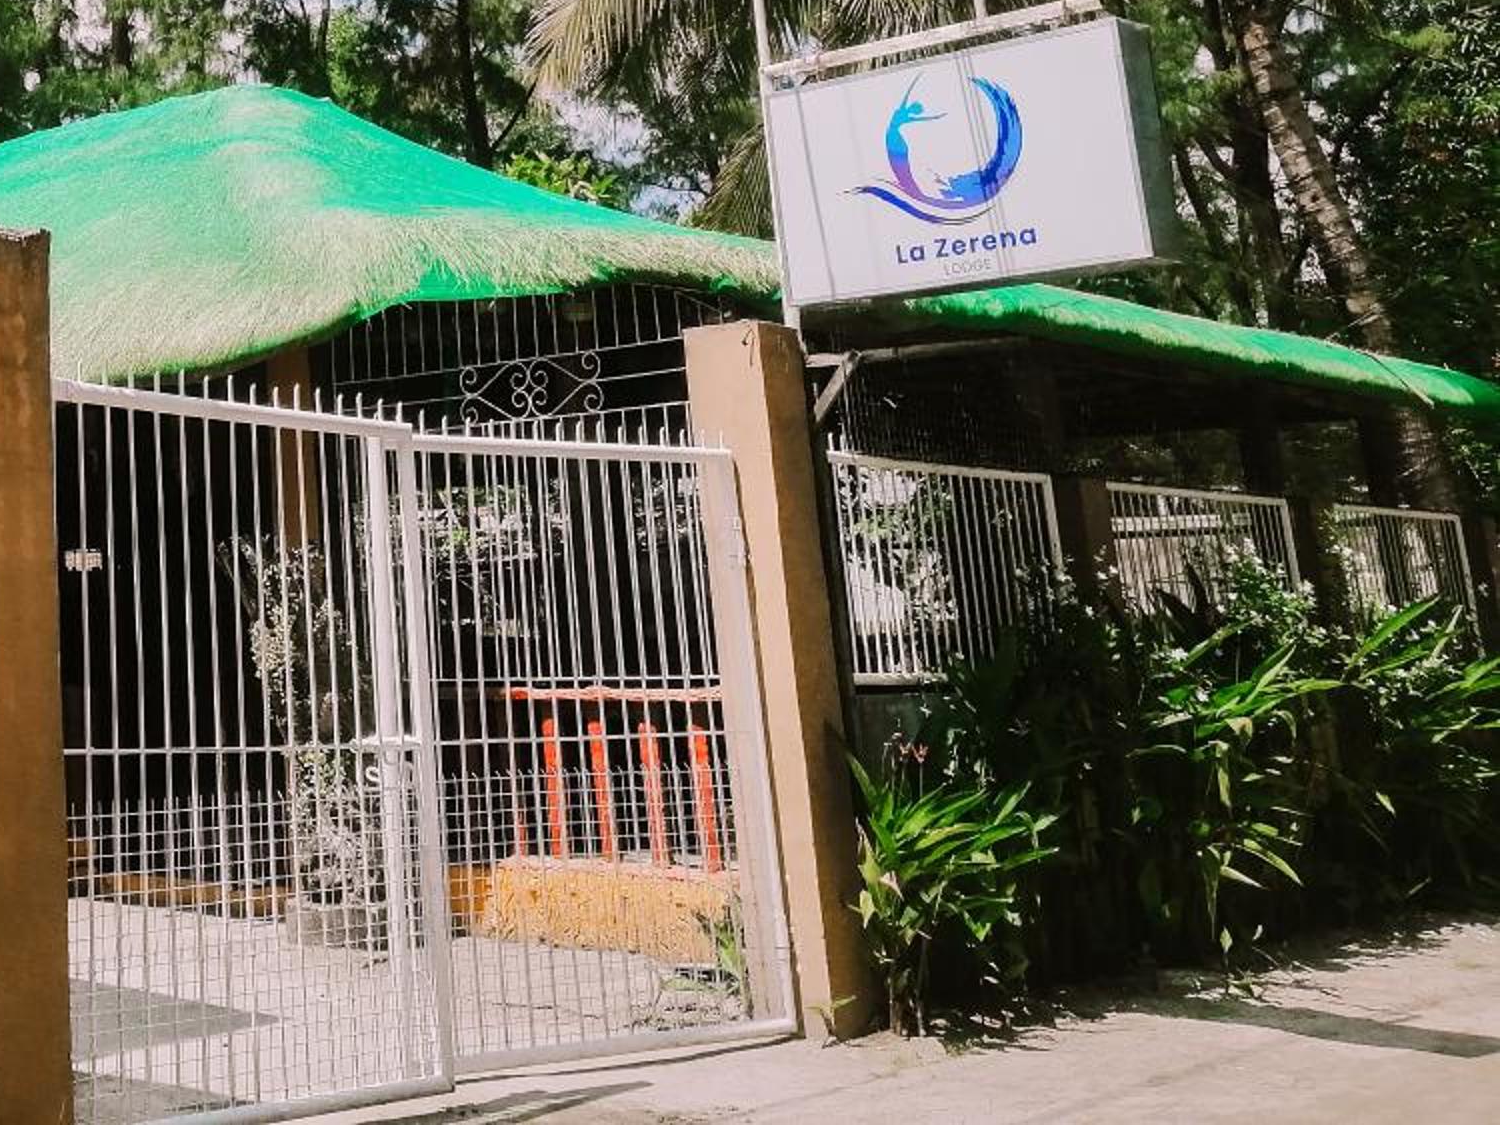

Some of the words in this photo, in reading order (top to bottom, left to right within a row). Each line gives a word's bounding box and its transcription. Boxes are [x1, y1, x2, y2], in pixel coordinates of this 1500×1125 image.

[896, 244, 925, 264] La
[934, 227, 1037, 258] Zerena
[944, 258, 992, 275] LODGE
